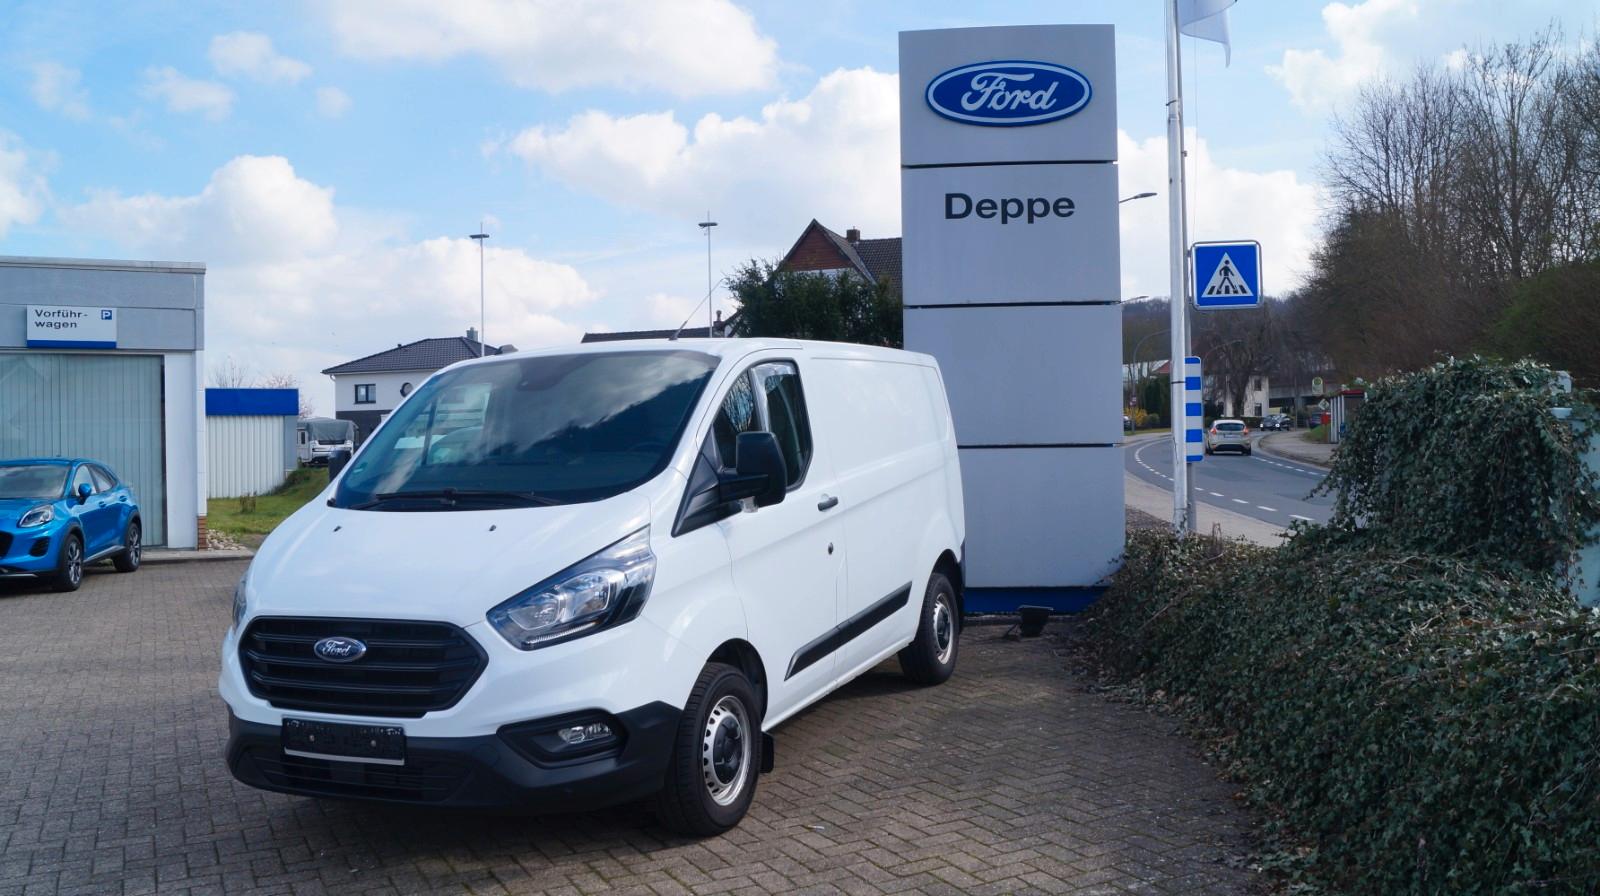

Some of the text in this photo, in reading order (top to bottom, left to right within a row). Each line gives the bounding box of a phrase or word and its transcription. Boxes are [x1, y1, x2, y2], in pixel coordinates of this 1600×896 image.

[961, 72, 1059, 111] Ford
[945, 193, 1075, 224] Deppe
[35, 309, 88, 318] Vorführ-
[102, 311, 111, 319] P
[35, 321, 78, 329] wagen
[322, 640, 351, 656] Ford
